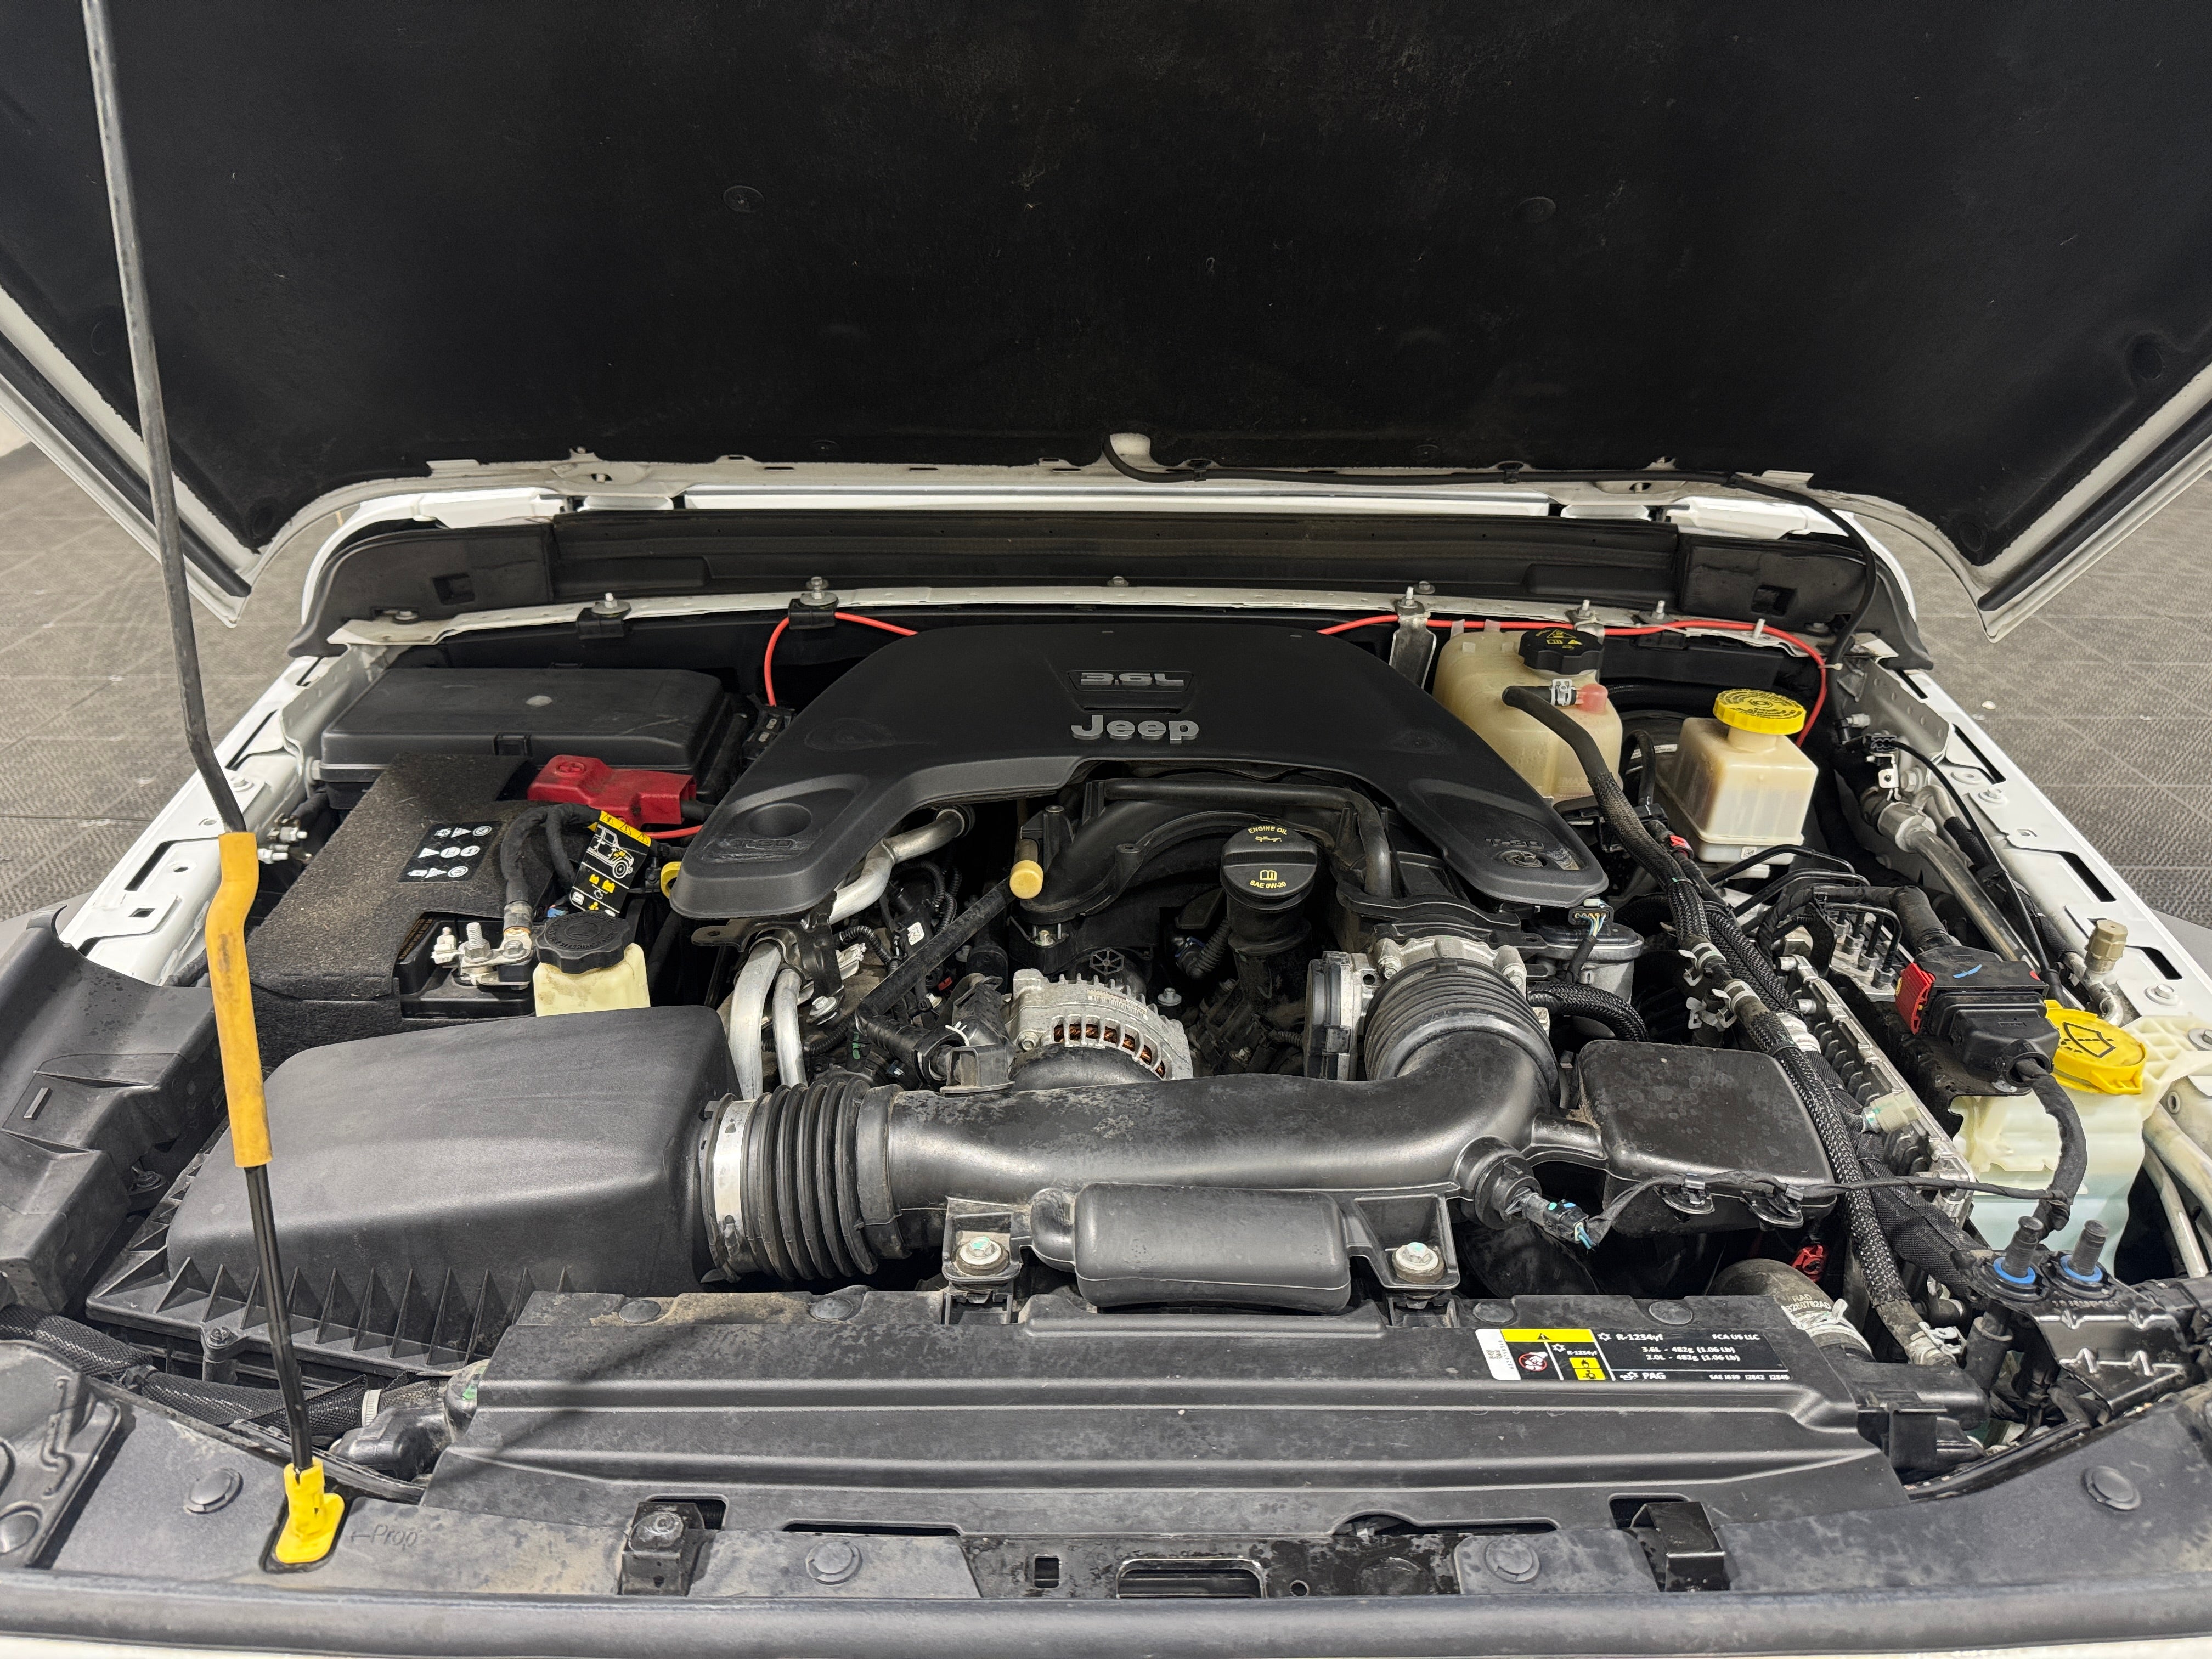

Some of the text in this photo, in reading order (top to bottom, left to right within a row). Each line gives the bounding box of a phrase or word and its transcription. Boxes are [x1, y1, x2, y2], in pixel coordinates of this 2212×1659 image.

[1080, 672, 1184, 686] 3.6L
[1071, 714, 1199, 744] Jeep
[1247, 825, 1288, 836] ENGINE OIL
[1249, 879, 1287, 889] SAE 0W-20
[1791, 1294, 1813, 1302] RAD
[1615, 1333, 1664, 1342] R-1234yf
[1641, 1372, 1667, 1380] PAG
[371, 1523, 417, 1551] Prop
